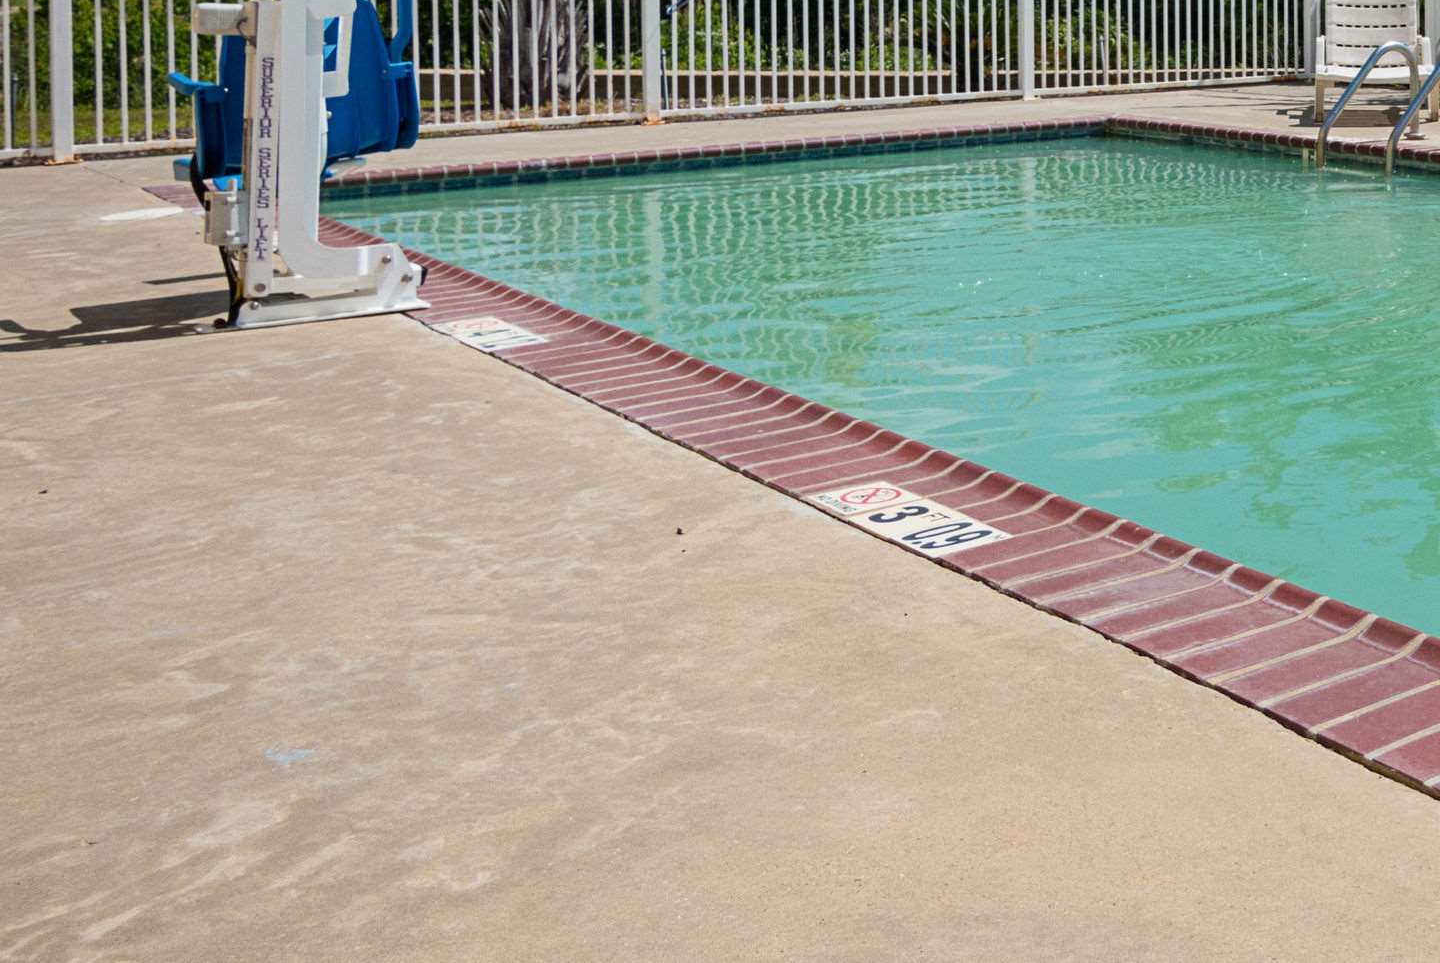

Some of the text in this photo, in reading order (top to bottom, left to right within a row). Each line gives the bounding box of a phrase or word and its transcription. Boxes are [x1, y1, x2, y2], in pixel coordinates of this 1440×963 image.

[255, 57, 274, 260] SUPERIOR SERIES LIFT
[868, 505, 929, 524] 3
[901, 522, 993, 549] 0.9
